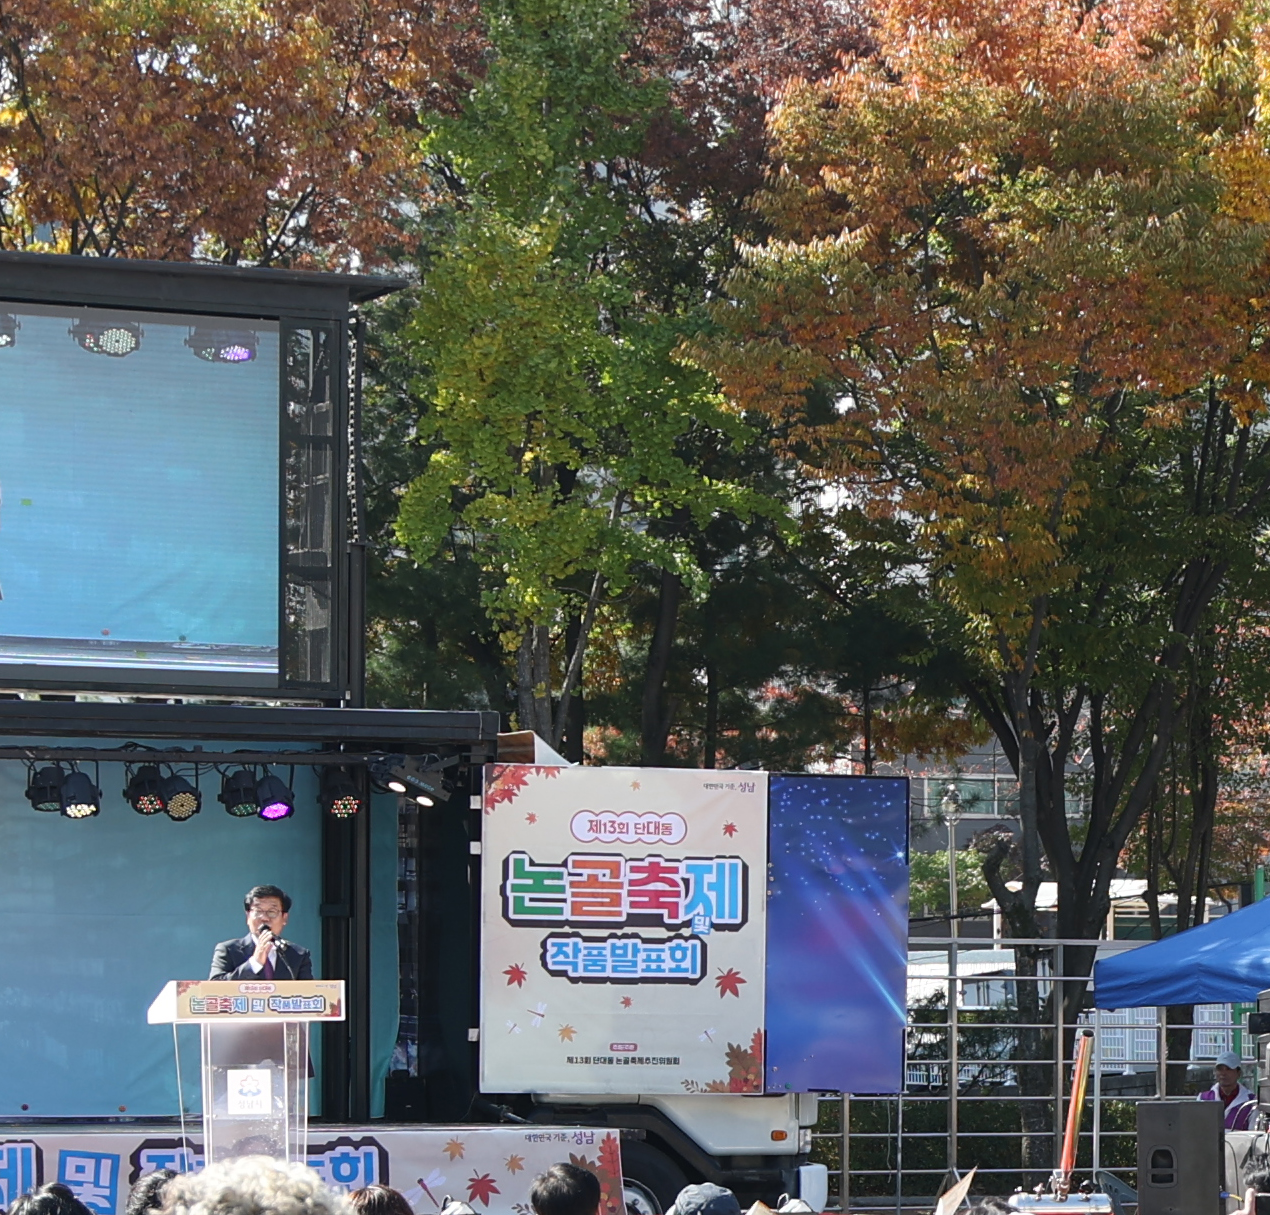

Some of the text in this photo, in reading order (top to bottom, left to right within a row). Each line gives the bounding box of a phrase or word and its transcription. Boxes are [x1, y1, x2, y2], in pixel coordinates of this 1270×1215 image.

[738, 781, 756, 793] 성남
[586, 819, 673, 836] 제13회 단대동
[509, 857, 739, 920] 논골축제
[692, 915, 712, 934] 및
[549, 940, 698, 975] 작품발표회
[191, 997, 247, 1012] 논골축제
[270, 998, 323, 1010] 작품발표회
[566, 1056, 591, 1065] 제13회
[593, 1056, 614, 1065] 단대동
[524, 1130, 595, 1145] 대한민국 기준, 성남
[61, 1153, 116, 1212] 및
